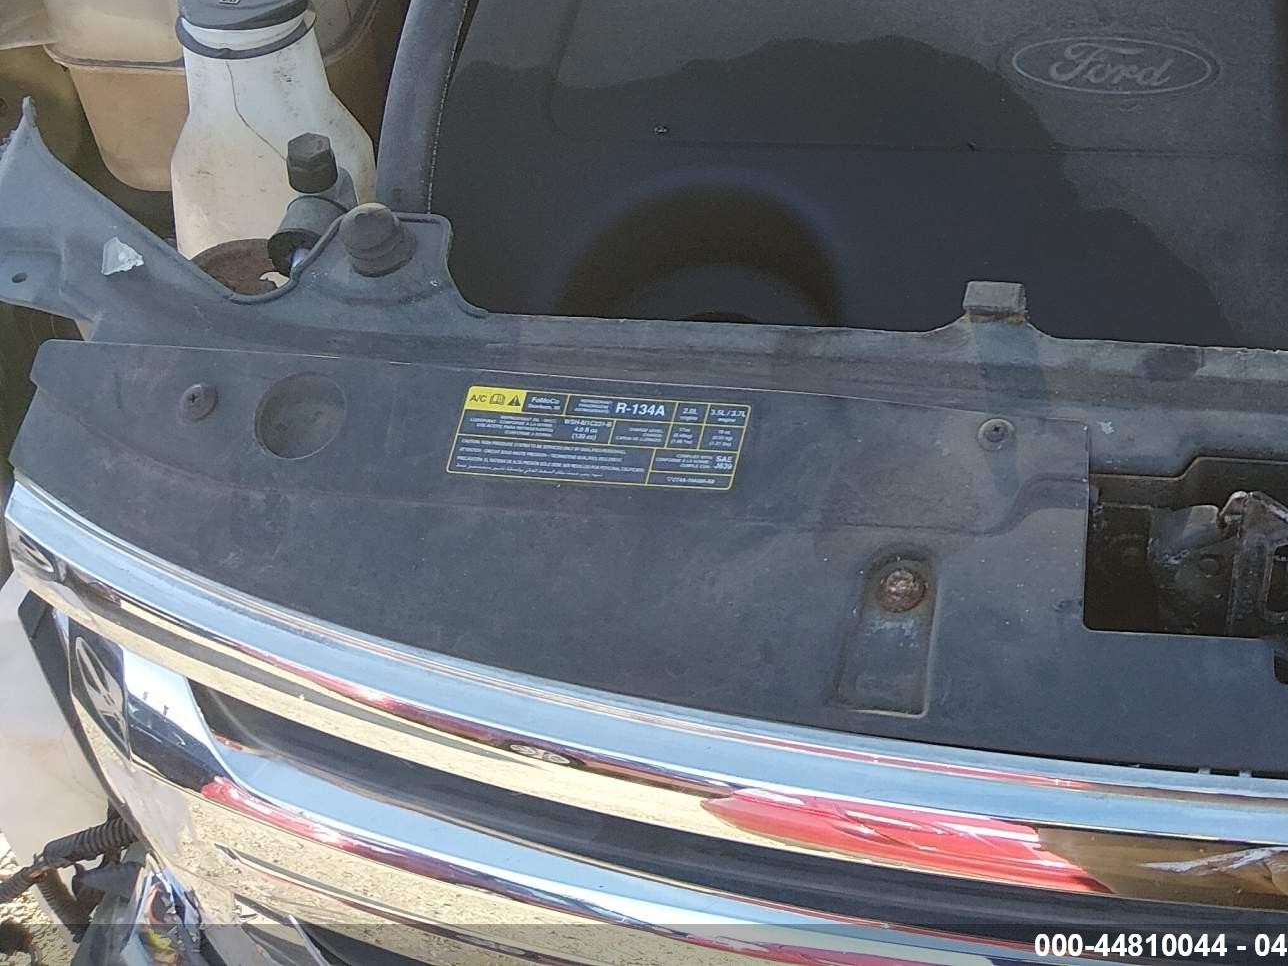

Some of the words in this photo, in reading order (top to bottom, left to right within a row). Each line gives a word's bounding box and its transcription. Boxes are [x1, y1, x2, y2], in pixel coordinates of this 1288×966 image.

[1050, 42, 1174, 87] Ford
[469, 393, 487, 403] A/C
[615, 401, 665, 417] R-134A
